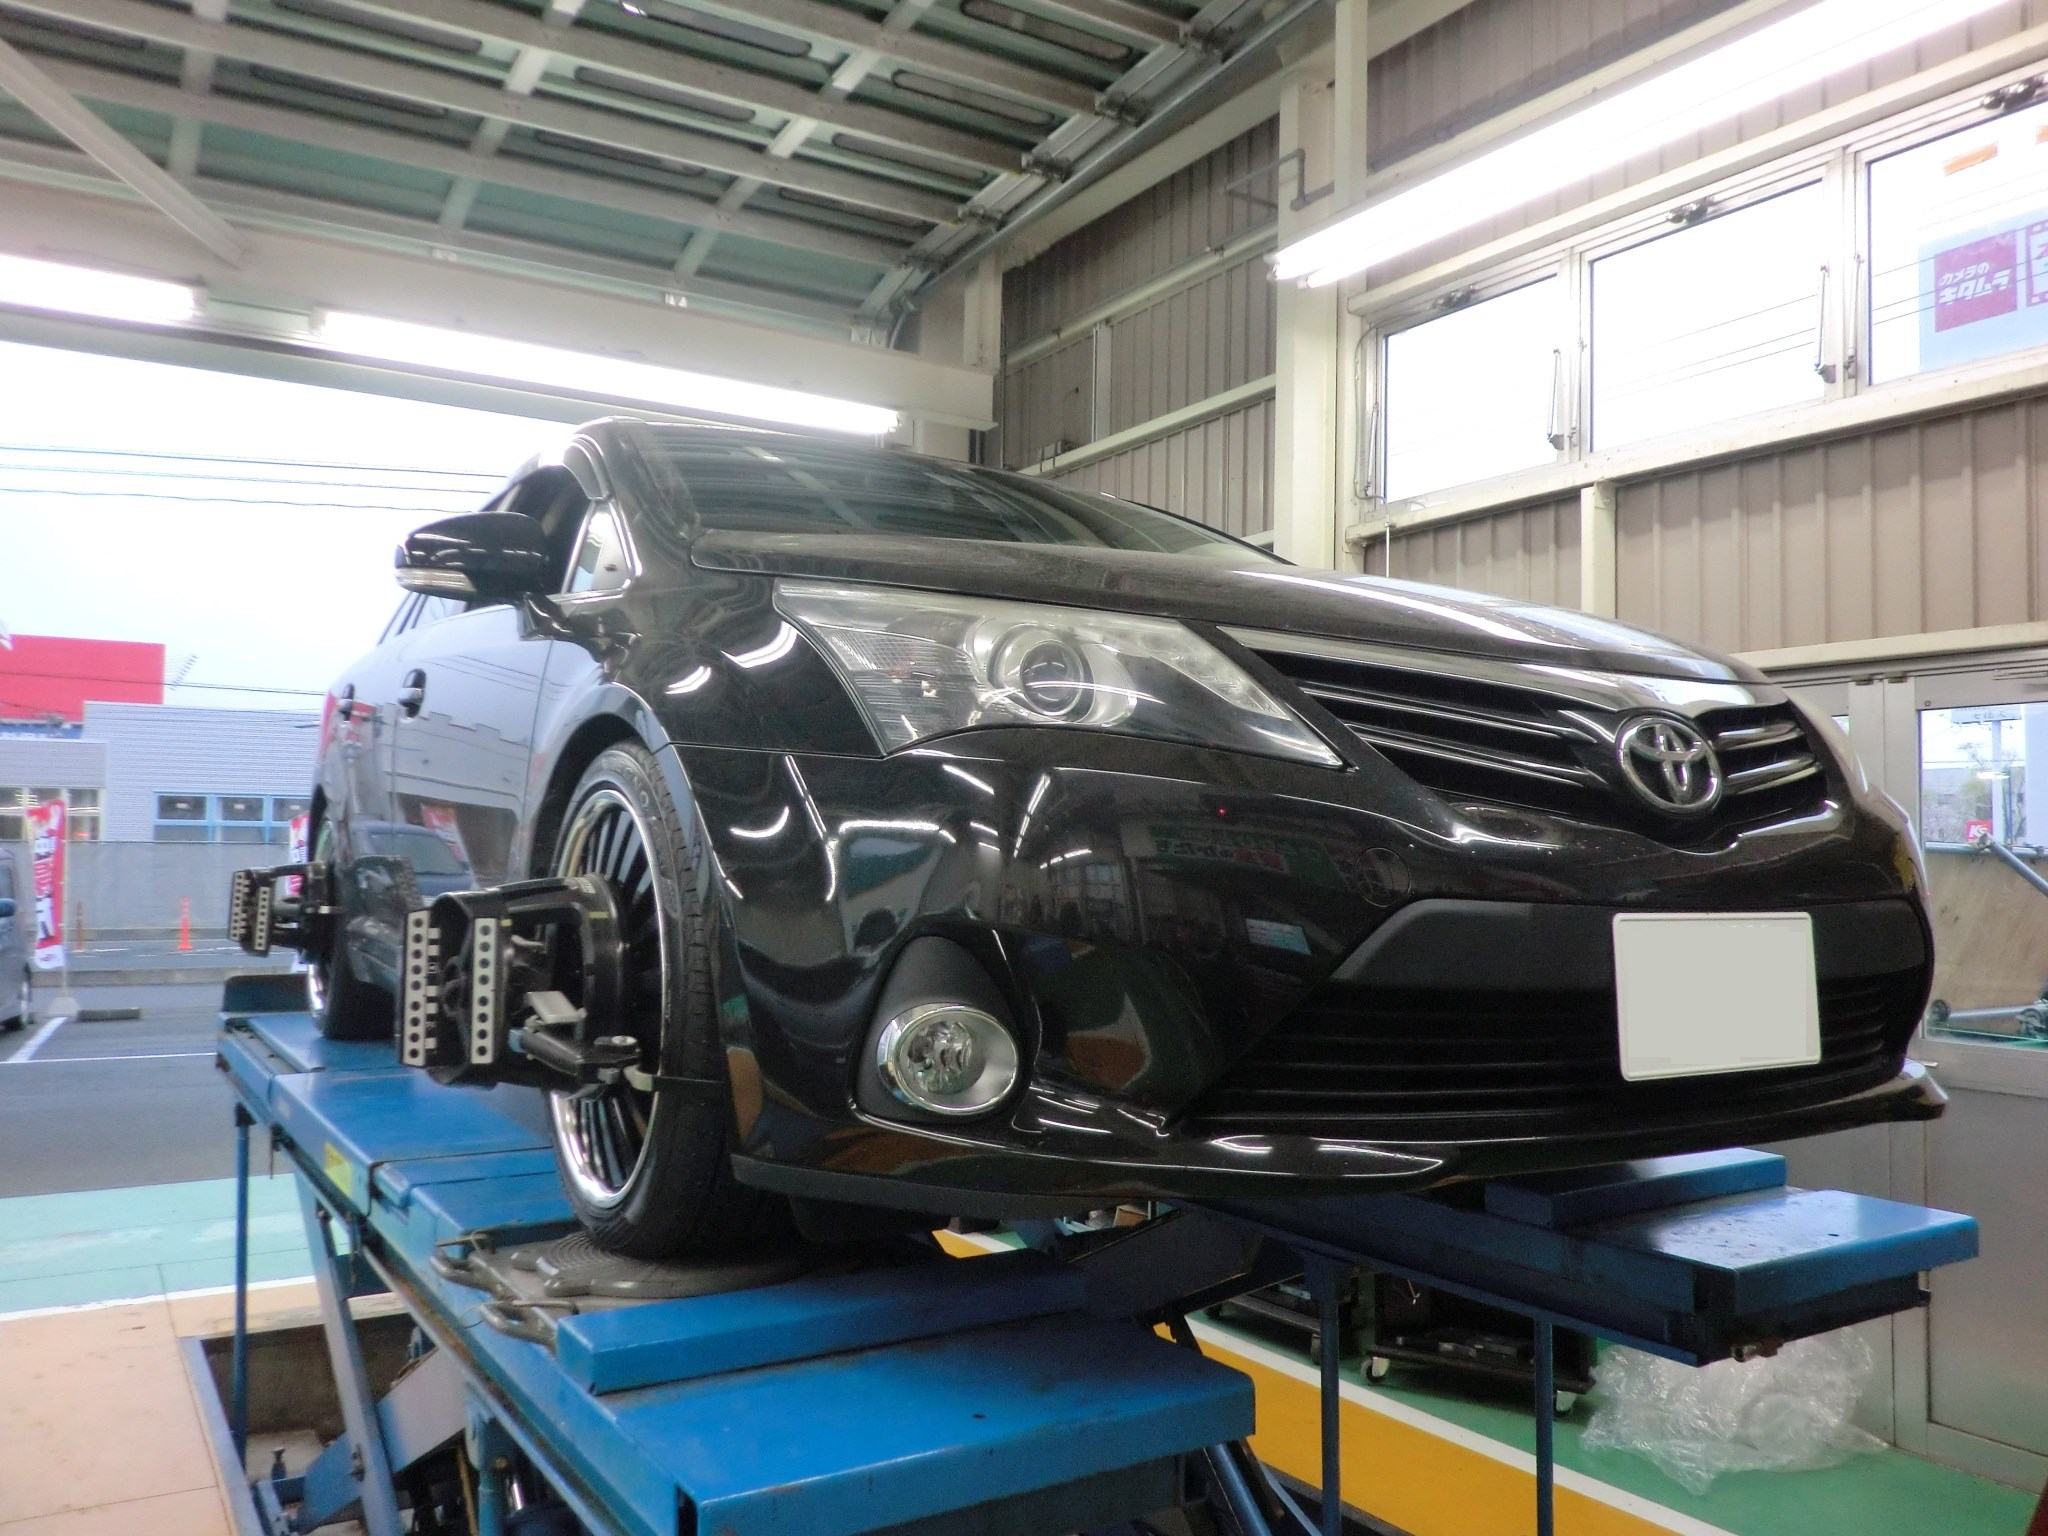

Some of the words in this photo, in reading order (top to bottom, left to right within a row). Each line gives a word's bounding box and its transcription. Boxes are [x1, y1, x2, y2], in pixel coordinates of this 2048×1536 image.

[1938, 262, 1990, 286] カメラの
[1938, 268, 2012, 305] キタムラ
